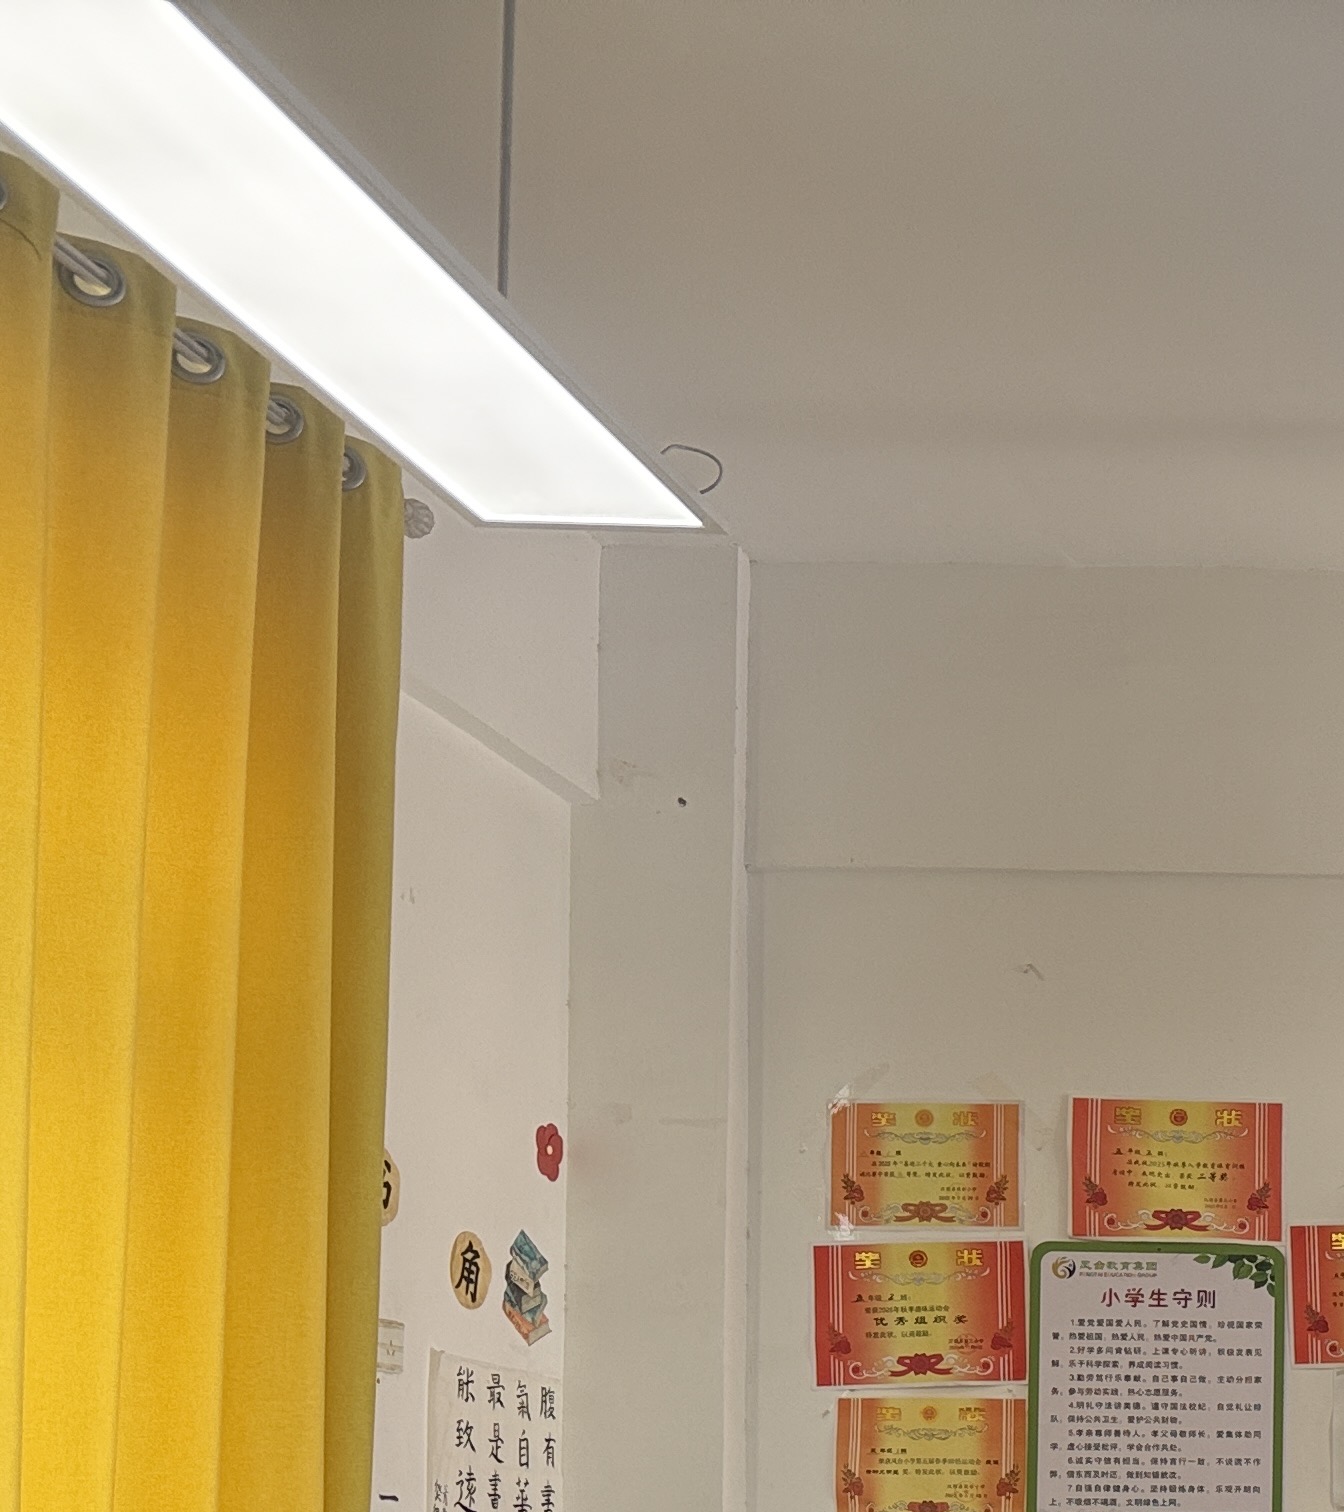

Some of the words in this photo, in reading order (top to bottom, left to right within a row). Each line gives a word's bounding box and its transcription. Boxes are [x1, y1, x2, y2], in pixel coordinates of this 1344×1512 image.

[455, 1240, 481, 1304] 角
[1101, 1287, 1217, 1309] 小学生守则
[873, 1314, 969, 1327] 优秀组织奖
